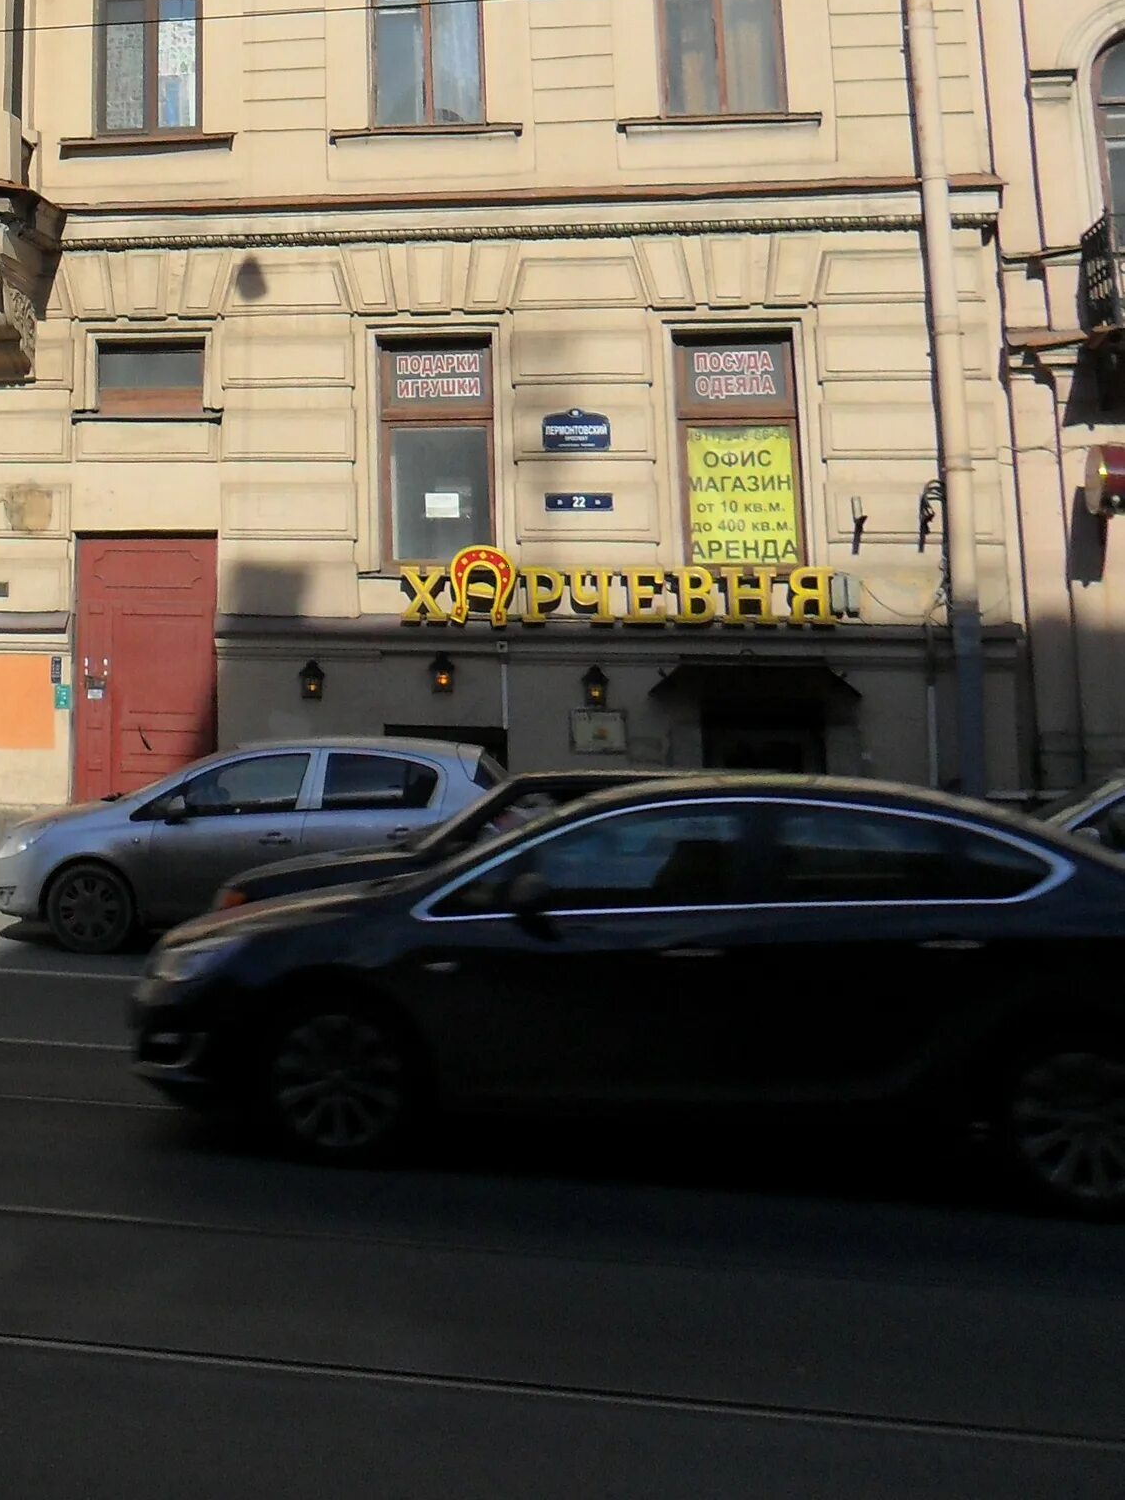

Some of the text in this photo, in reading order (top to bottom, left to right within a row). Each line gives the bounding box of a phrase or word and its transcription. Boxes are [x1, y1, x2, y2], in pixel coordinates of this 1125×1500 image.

[397, 354, 479, 376] ПОДАРКИ
[694, 351, 774, 374] ПОСУДА
[397, 378, 480, 398] ИГРУШКИ
[696, 375, 776, 399] ОДЕЯЛА
[703, 450, 772, 468] ОФИС
[689, 474, 791, 493] МАГАЗИН
[572, 496, 586, 508] 22
[697, 503, 714, 513] от
[722, 500, 738, 513] 10
[693, 522, 713, 533] до
[717, 519, 746, 532] 400
[692, 539, 797, 563] АРЕНДА
[400, 545, 838, 626] ХАРЧЕВНЯ
